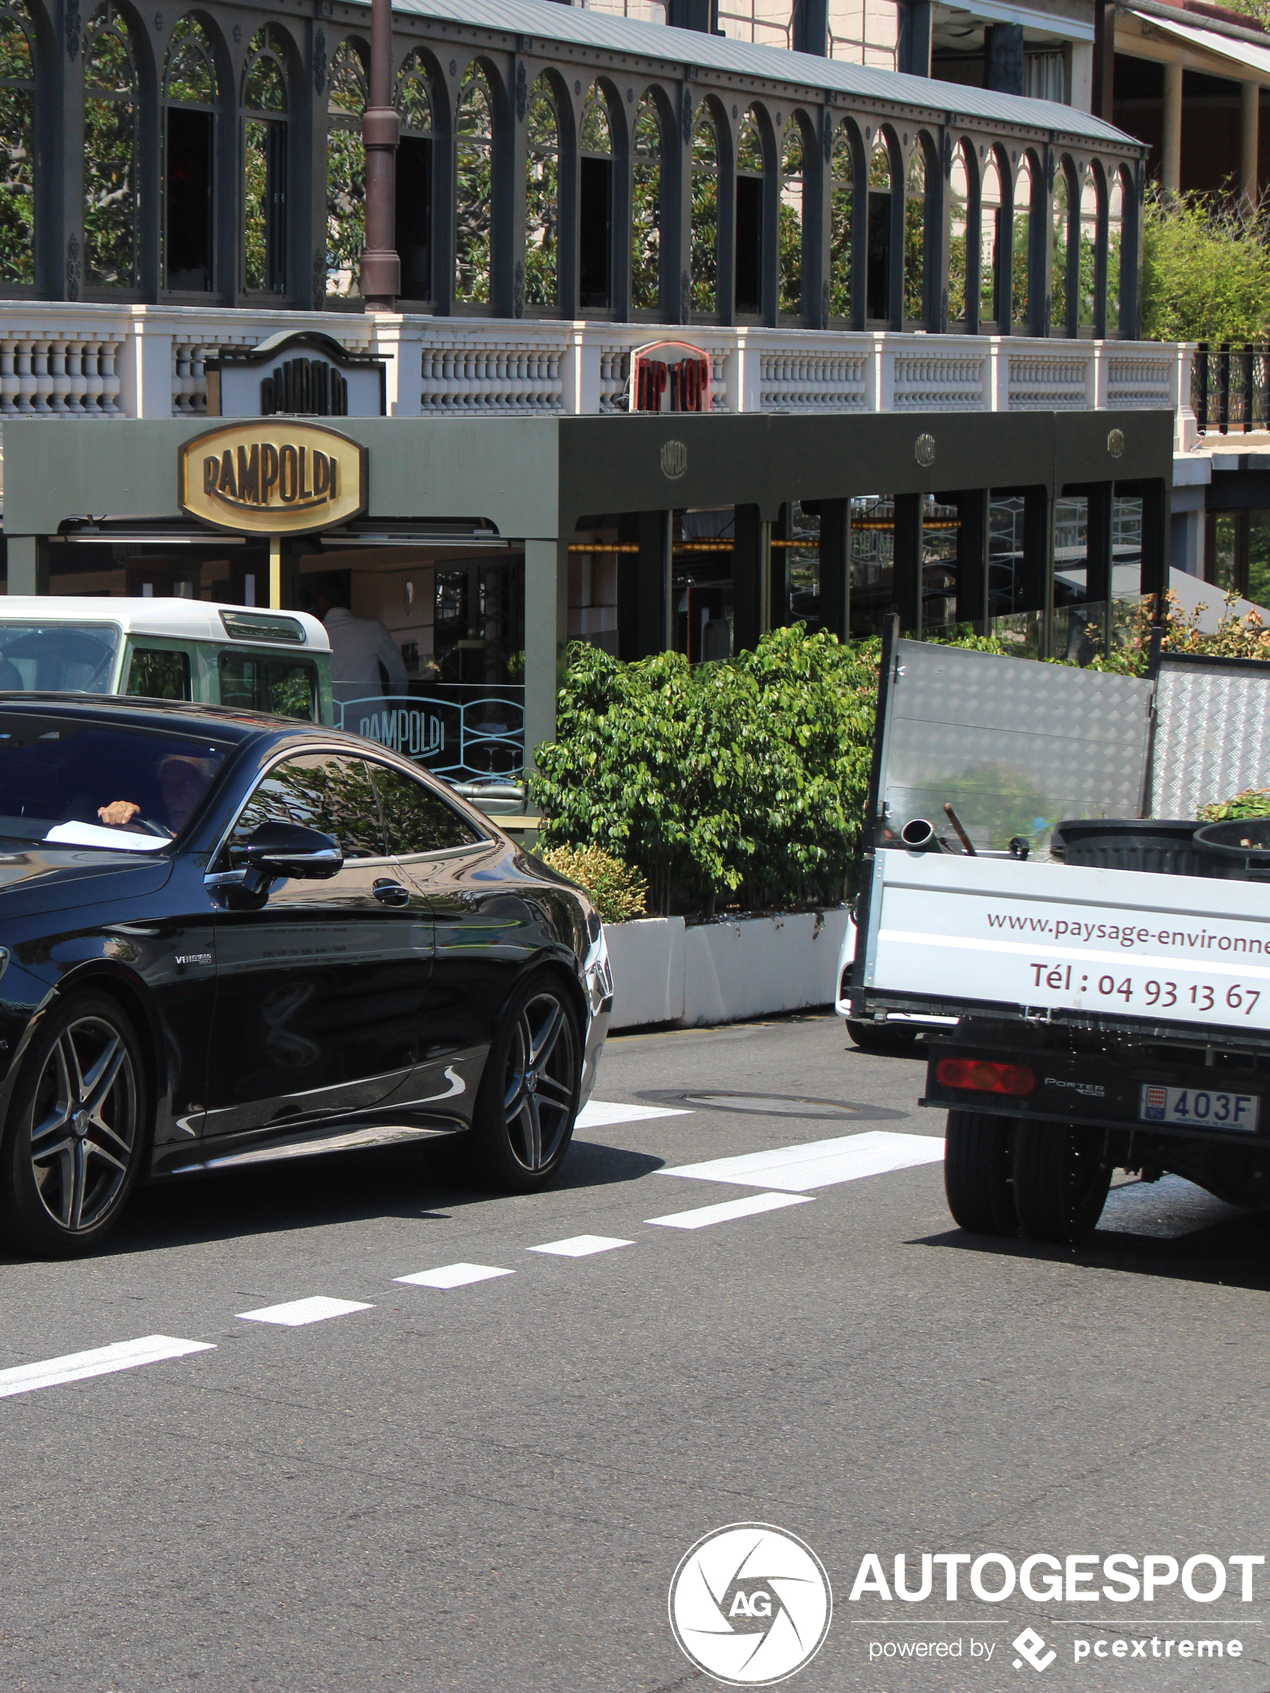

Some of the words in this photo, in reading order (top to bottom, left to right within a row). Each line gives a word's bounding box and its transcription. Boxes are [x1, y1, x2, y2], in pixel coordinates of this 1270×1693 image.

[204, 443, 338, 511] RAMPOLDI
[1030, 962, 1072, 990] Tél
[1081, 974, 1088, 991] :
[1098, 975, 1133, 1003] 04
[1145, 980, 1177, 1007] 93
[1189, 985, 1214, 1011] 13
[1226, 984, 1261, 1015] 67
[1173, 1090, 1252, 1122] 403F
